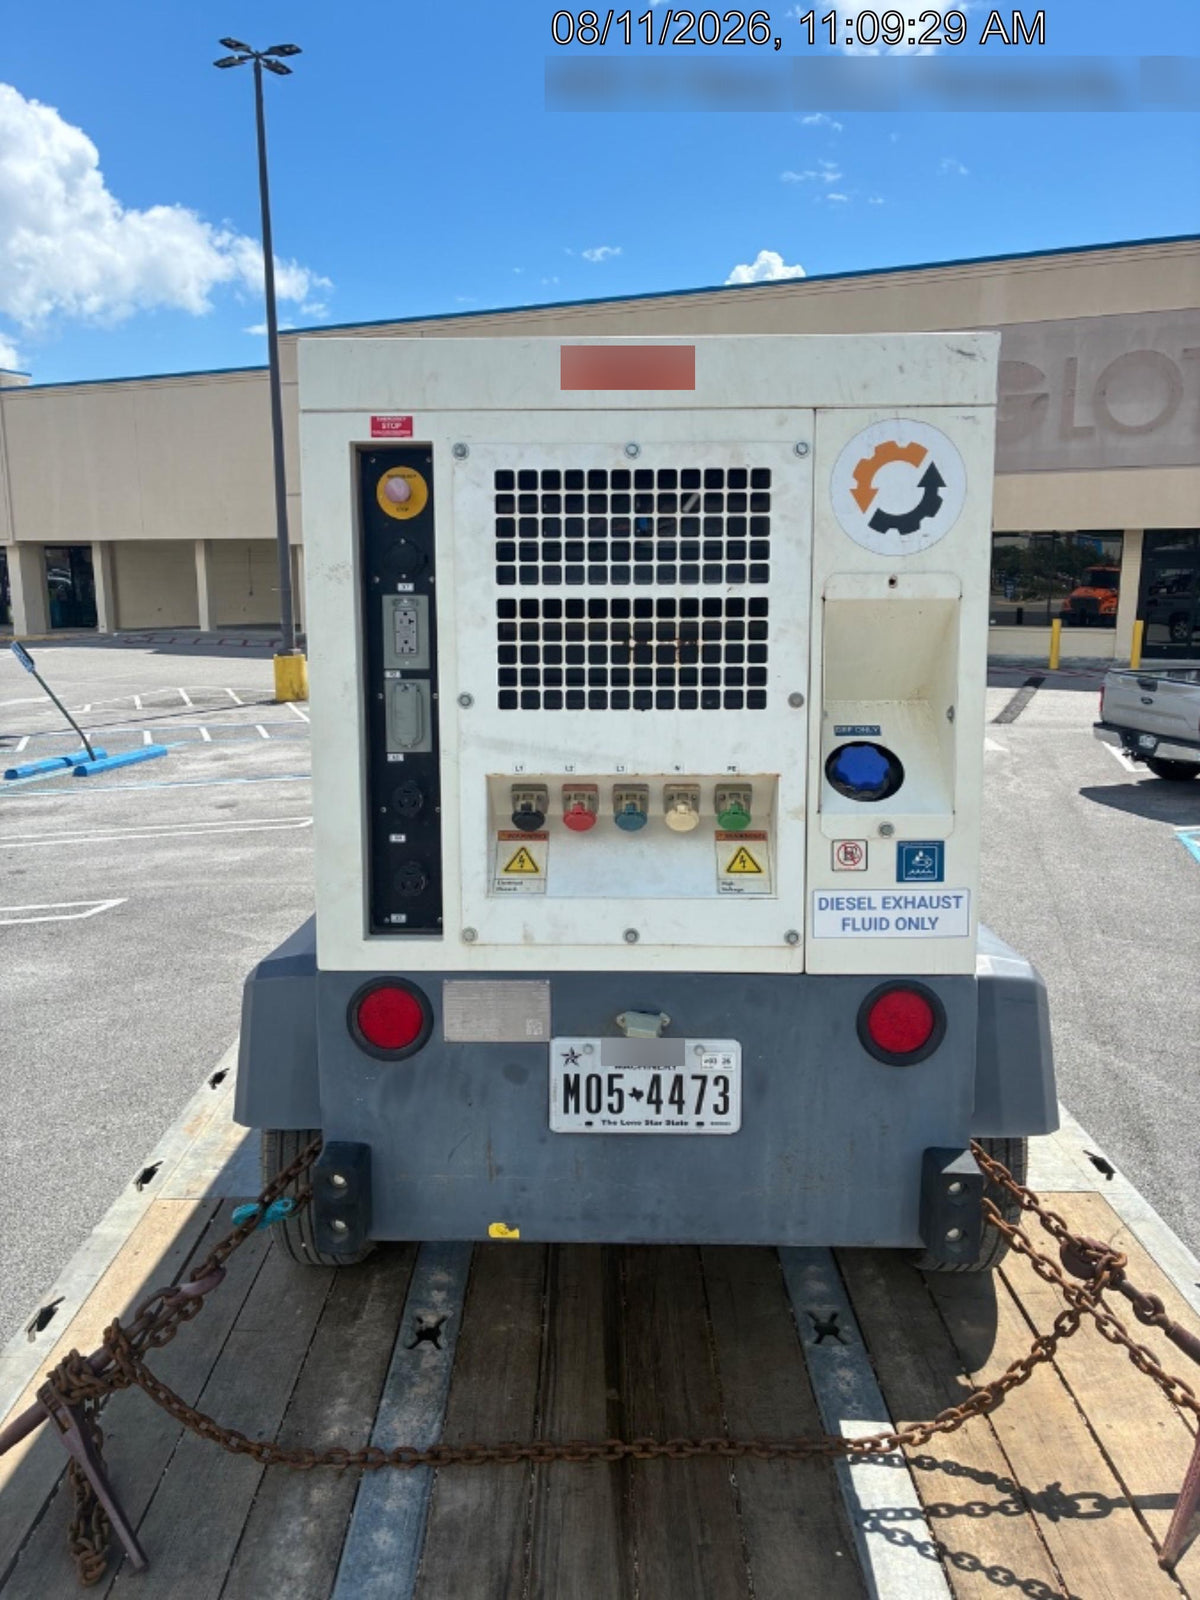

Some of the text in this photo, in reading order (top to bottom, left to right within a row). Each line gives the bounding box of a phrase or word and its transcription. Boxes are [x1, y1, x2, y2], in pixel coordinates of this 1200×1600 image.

[818, 895, 963, 911] DIESEL EXHAUST
[841, 916, 939, 932] FLUID ONLY
[563, 1073, 625, 1115] M05
[646, 1074, 731, 1116] 4473
